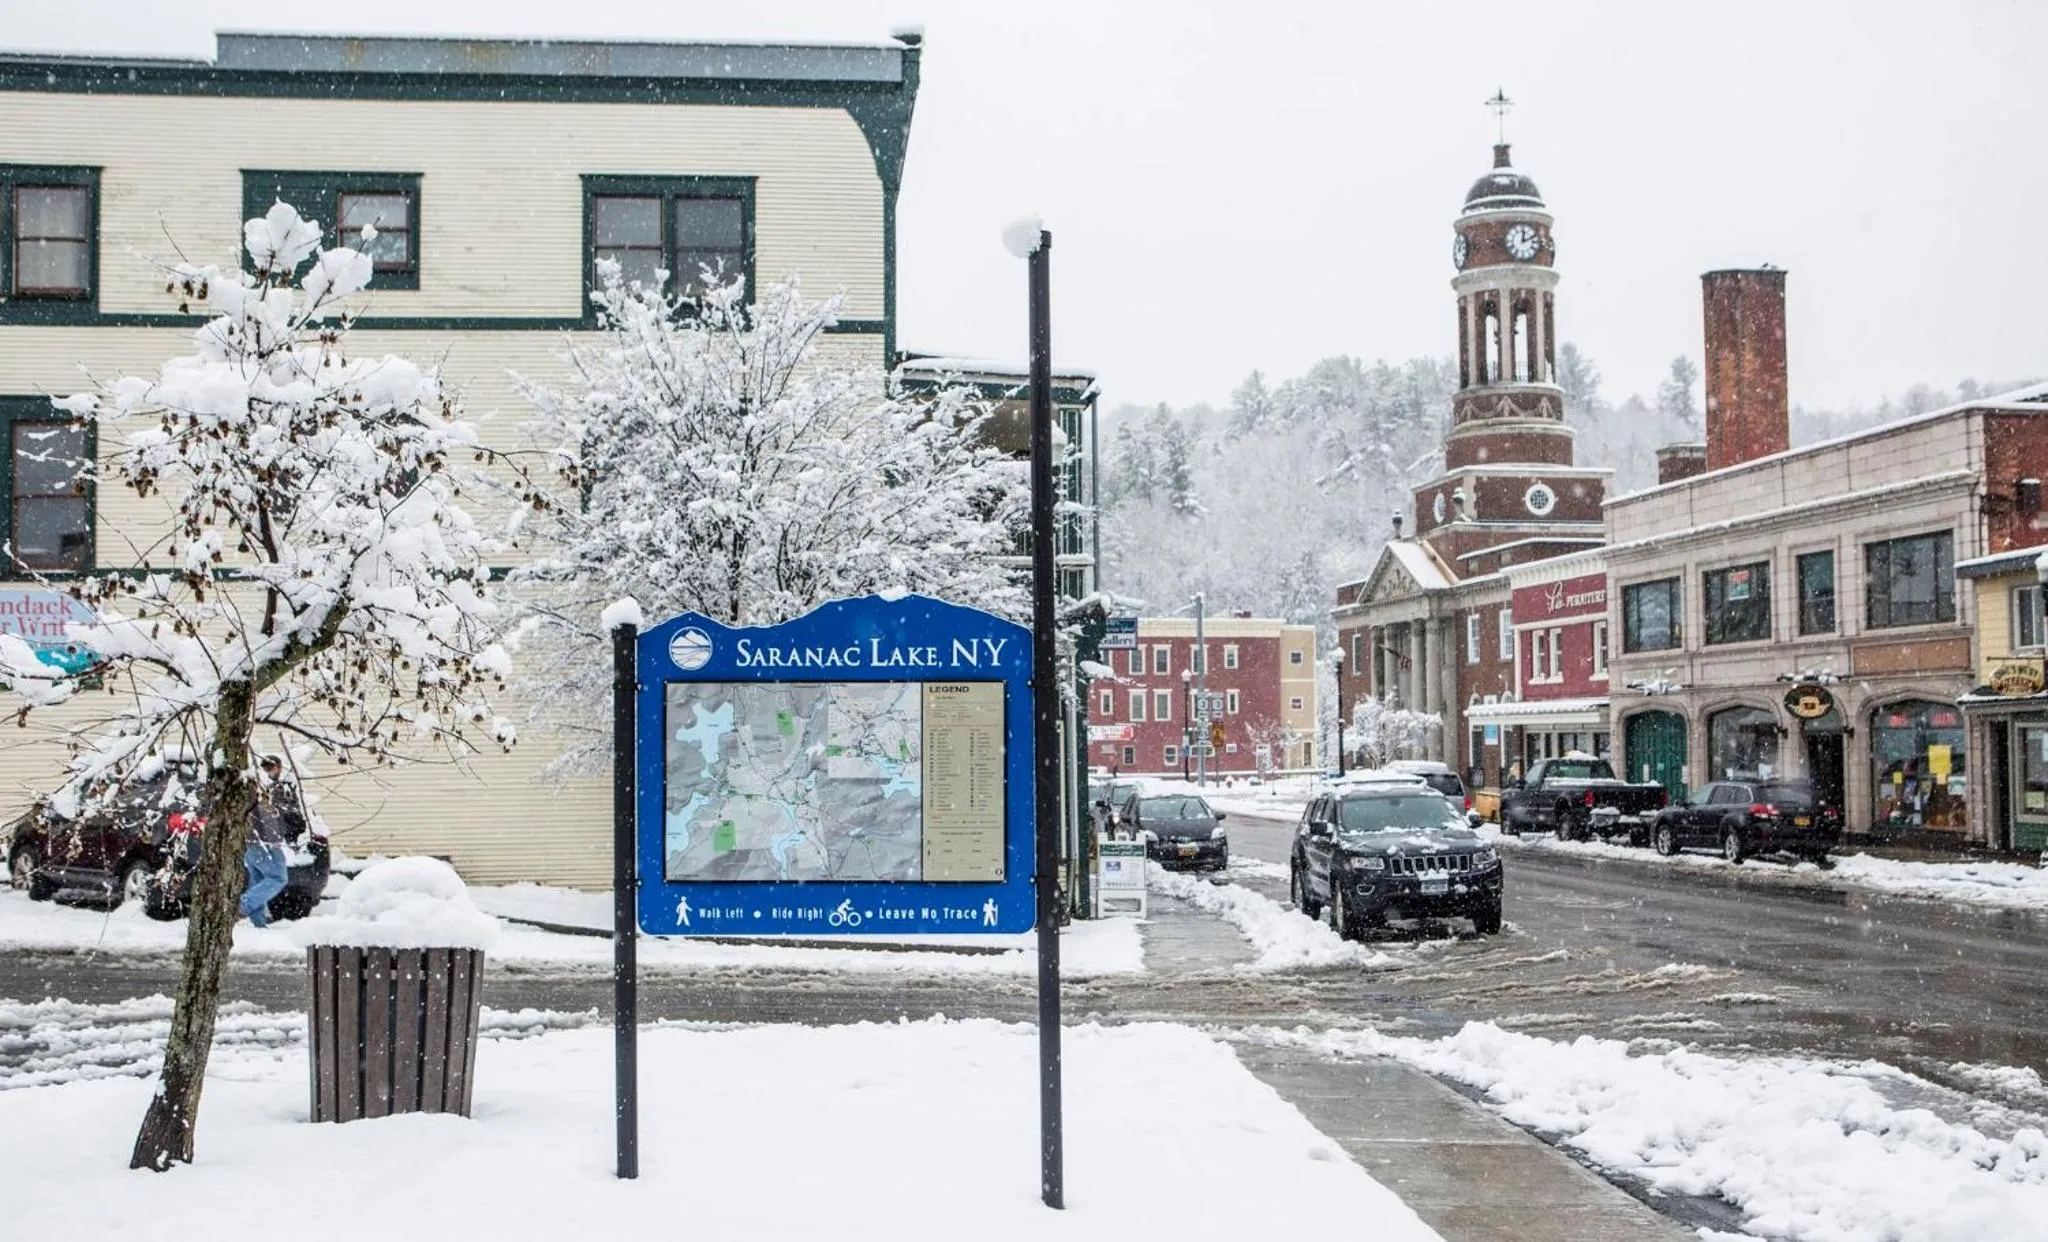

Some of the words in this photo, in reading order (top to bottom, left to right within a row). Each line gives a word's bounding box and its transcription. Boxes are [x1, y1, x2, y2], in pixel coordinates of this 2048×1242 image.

[951, 638, 1008, 667] NY
[699, 907, 721, 918] Walk
[725, 907, 744, 918] Left
[772, 907, 793, 919] Ride
[797, 907, 823, 921] Right
[879, 907, 915, 919] Leave
[921, 907, 937, 919] No
[943, 907, 978, 919] Trace
